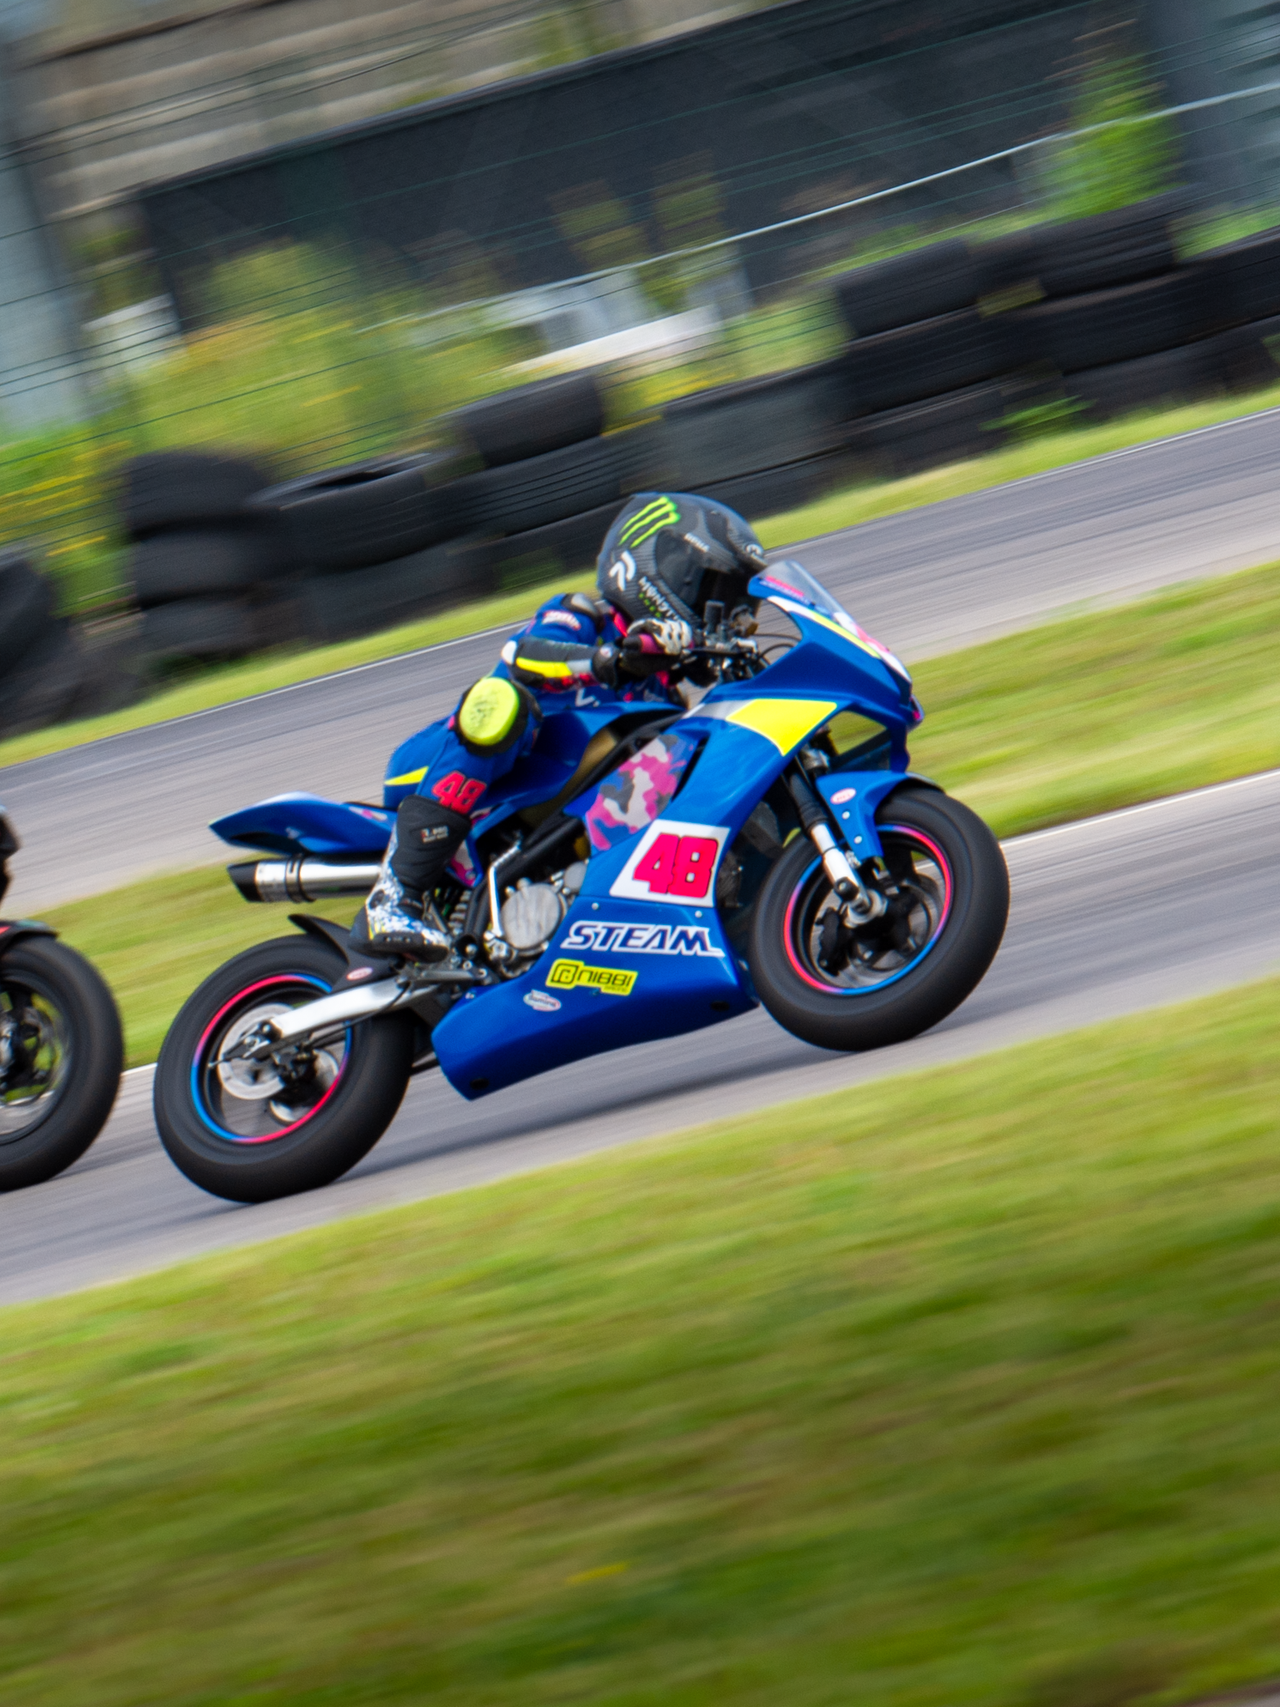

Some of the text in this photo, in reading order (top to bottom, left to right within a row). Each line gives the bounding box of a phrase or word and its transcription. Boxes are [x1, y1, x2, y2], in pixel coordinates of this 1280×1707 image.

[431, 770, 487, 815] 48
[632, 832, 719, 899] 48
[559, 920, 726, 958] STEAM
